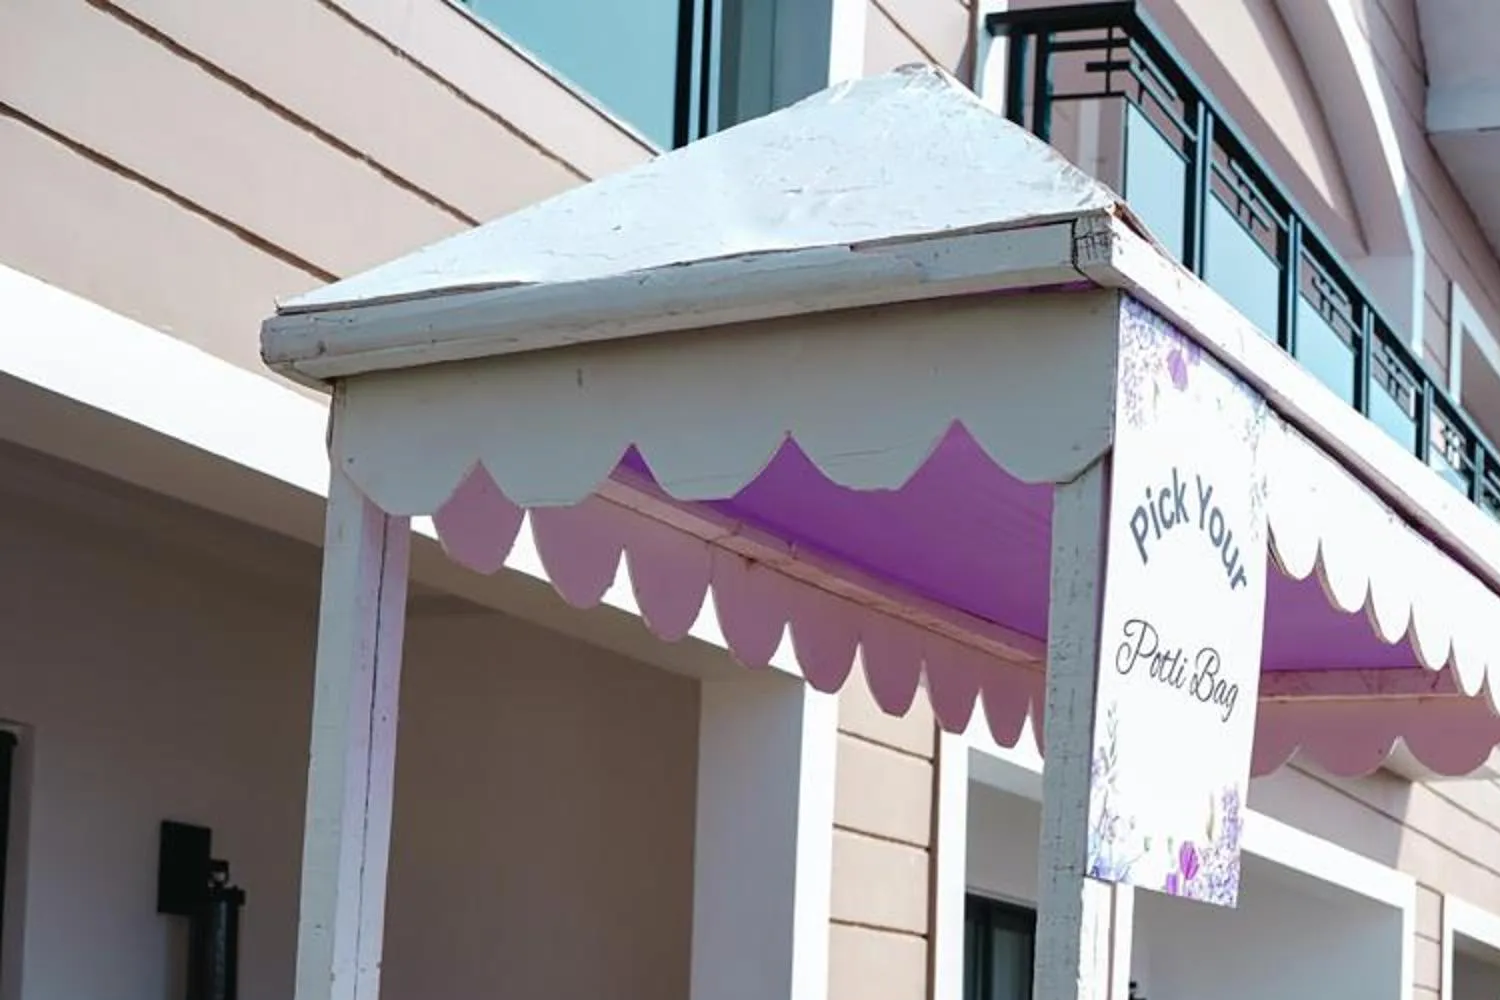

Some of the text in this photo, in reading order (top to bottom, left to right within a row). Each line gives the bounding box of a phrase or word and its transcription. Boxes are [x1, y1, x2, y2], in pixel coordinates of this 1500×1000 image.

[1196, 473, 1247, 591] Your
[1115, 618, 1239, 723] Potli Bag
